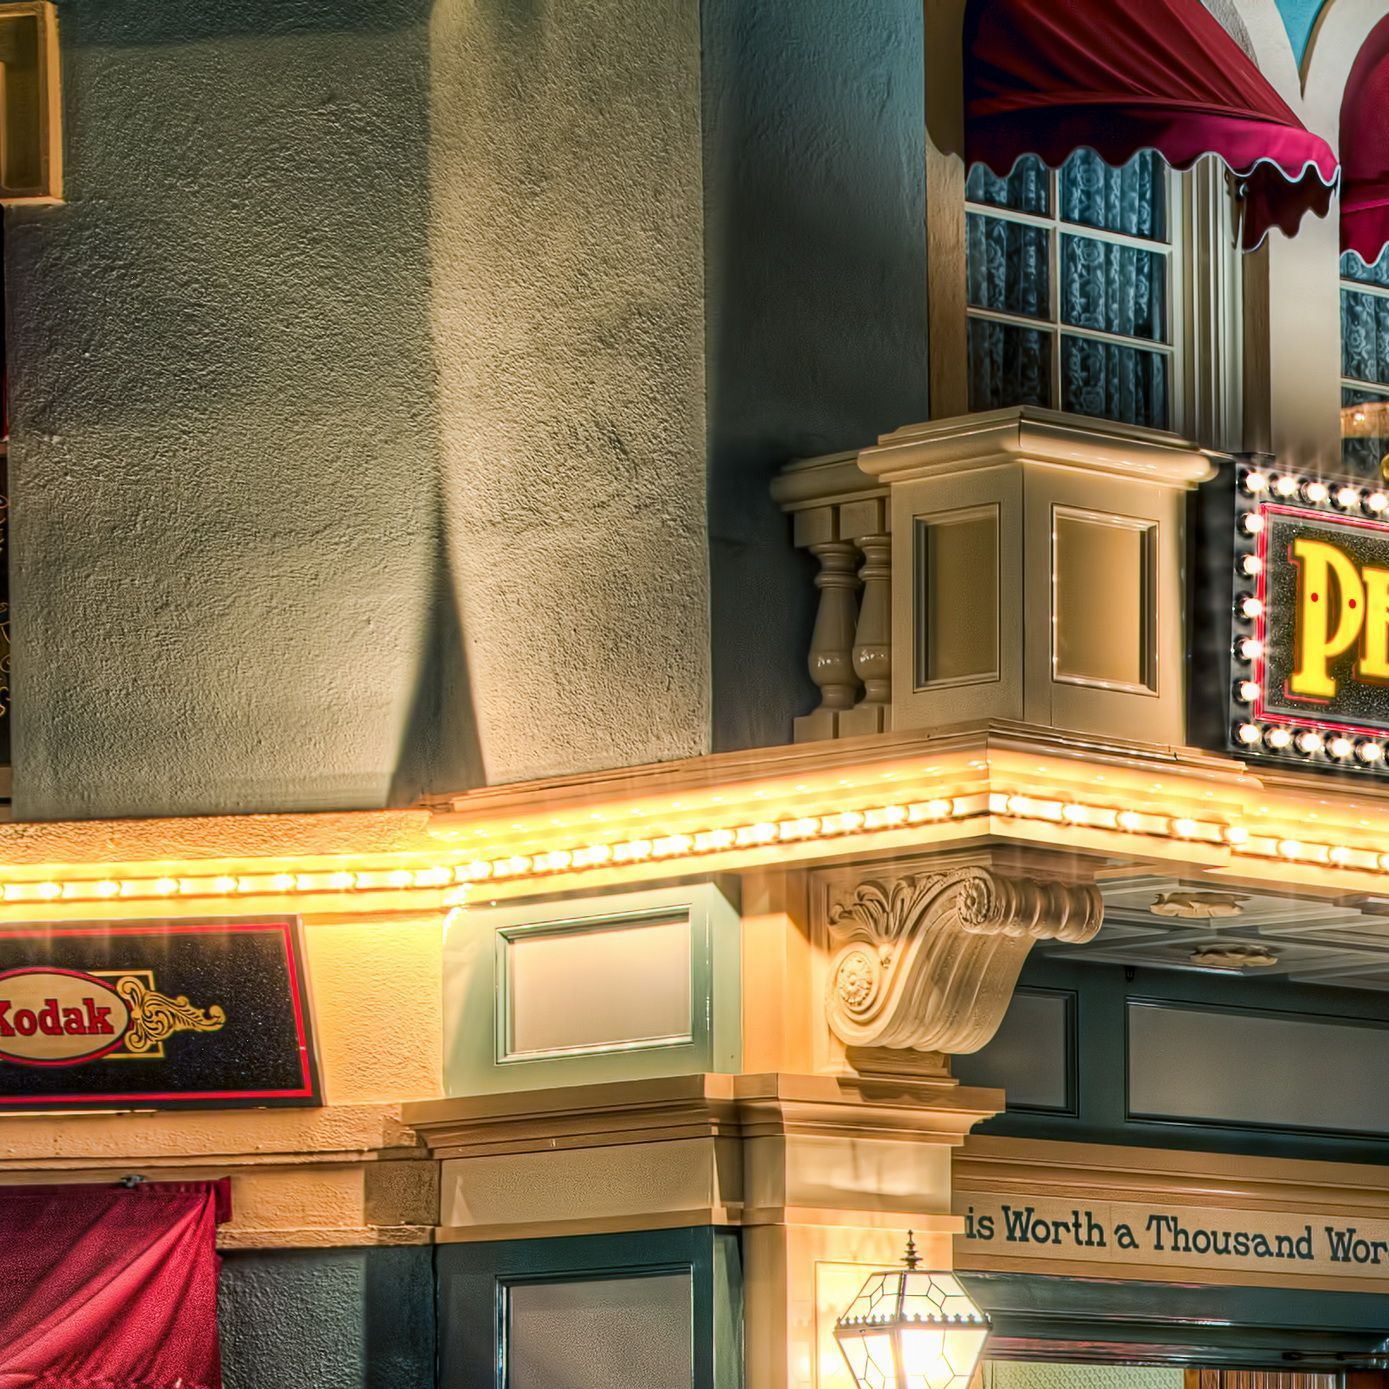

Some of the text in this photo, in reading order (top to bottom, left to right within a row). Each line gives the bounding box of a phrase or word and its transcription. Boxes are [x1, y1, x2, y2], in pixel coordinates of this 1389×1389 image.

[965, 1206, 995, 1240] is
[1002, 1205, 1106, 1248] Worth
[1114, 1224, 1139, 1250] a
[1146, 1214, 1313, 1260] Thousand
